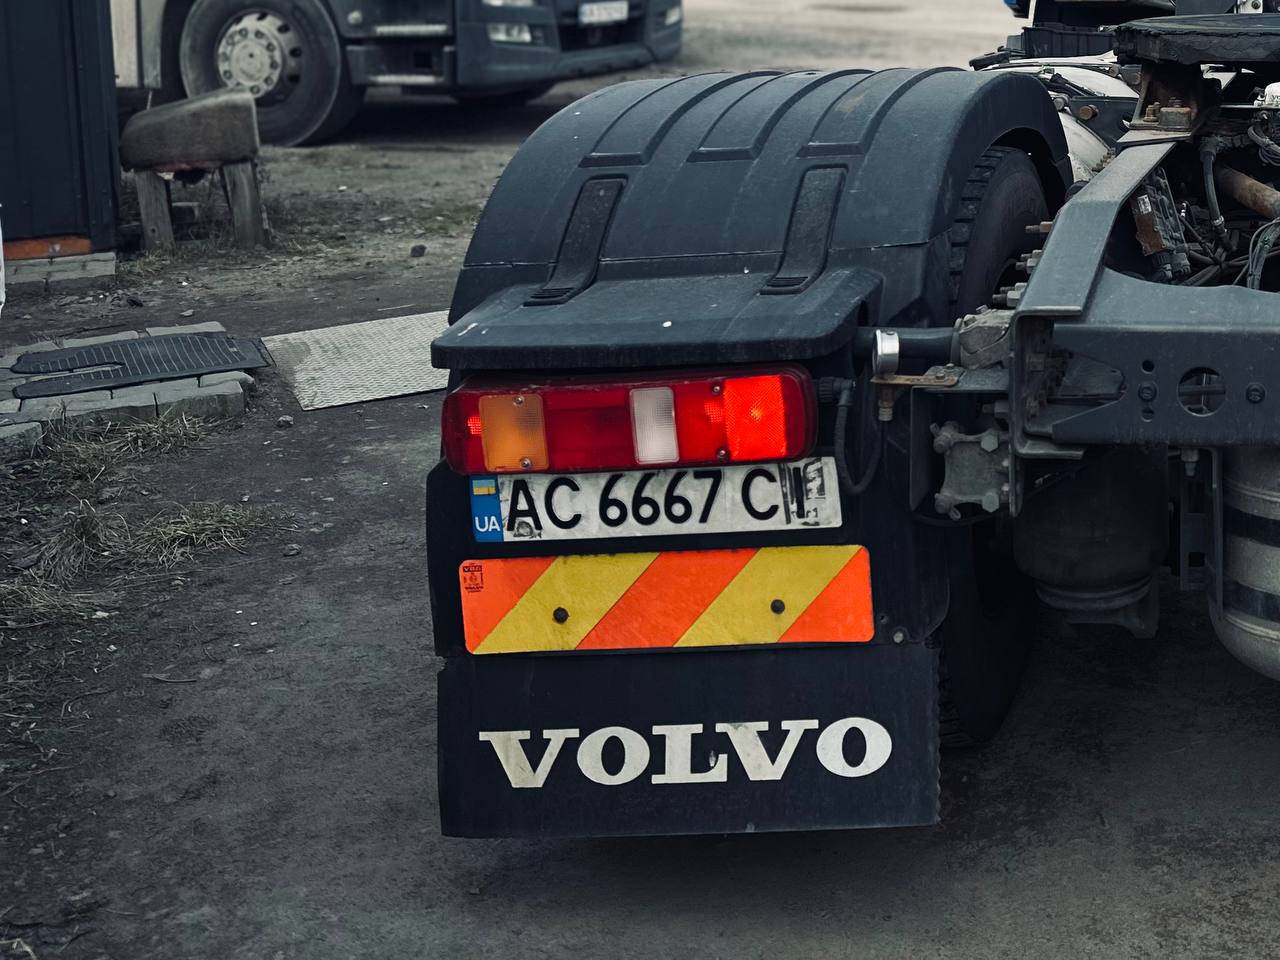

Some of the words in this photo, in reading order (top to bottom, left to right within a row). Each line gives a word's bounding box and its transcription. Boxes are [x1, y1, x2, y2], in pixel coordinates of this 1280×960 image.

[474, 515, 501, 532] UA
[506, 477, 582, 531] AC
[598, 470, 722, 528] 6667
[479, 717, 893, 788] VOLVO
